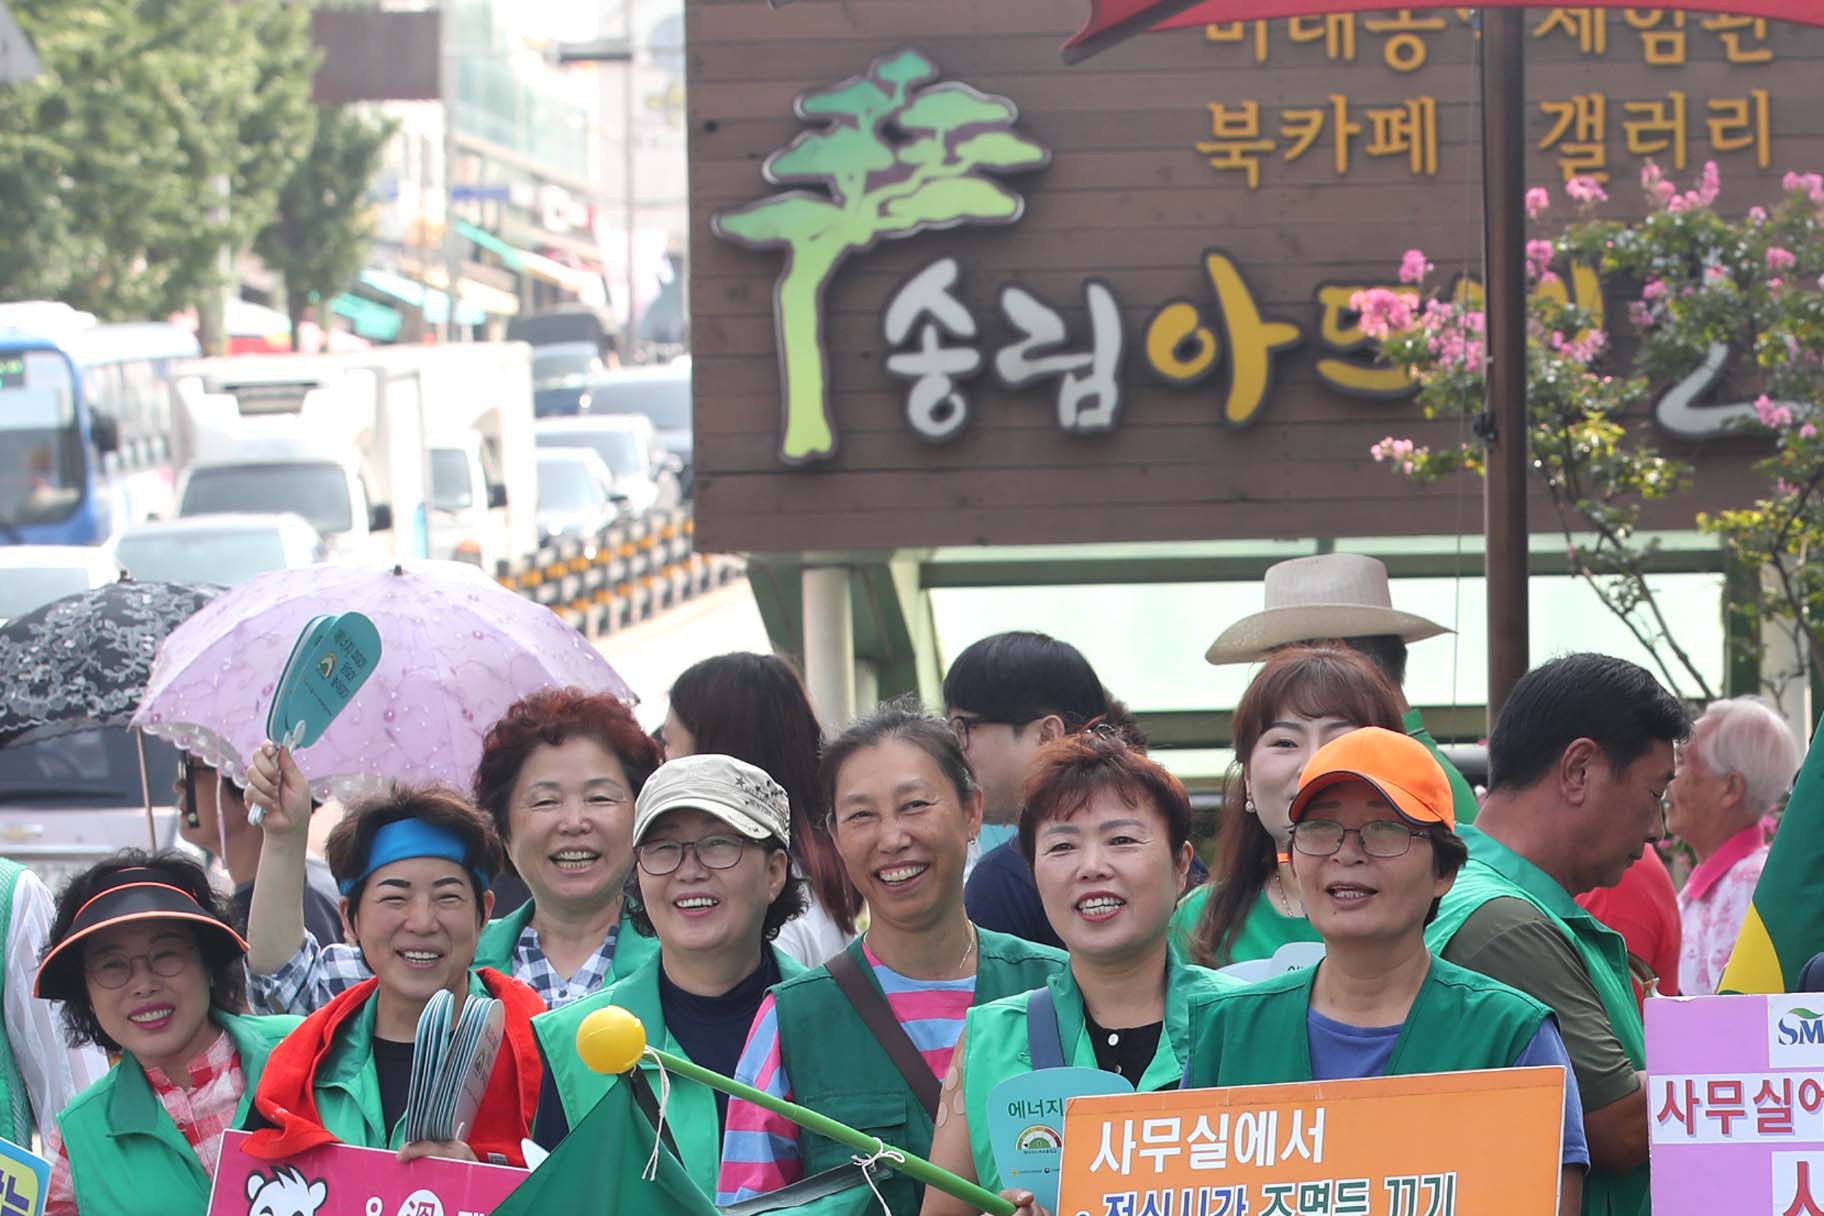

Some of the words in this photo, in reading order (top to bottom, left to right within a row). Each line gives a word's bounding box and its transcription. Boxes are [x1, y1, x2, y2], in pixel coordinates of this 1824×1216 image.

[1195, 94, 1438, 188] 북카페
[1538, 90, 1772, 183] 갤러리
[1008, 1098, 1064, 1119] 에너지
[1090, 1107, 1326, 1174] 사무실에서
